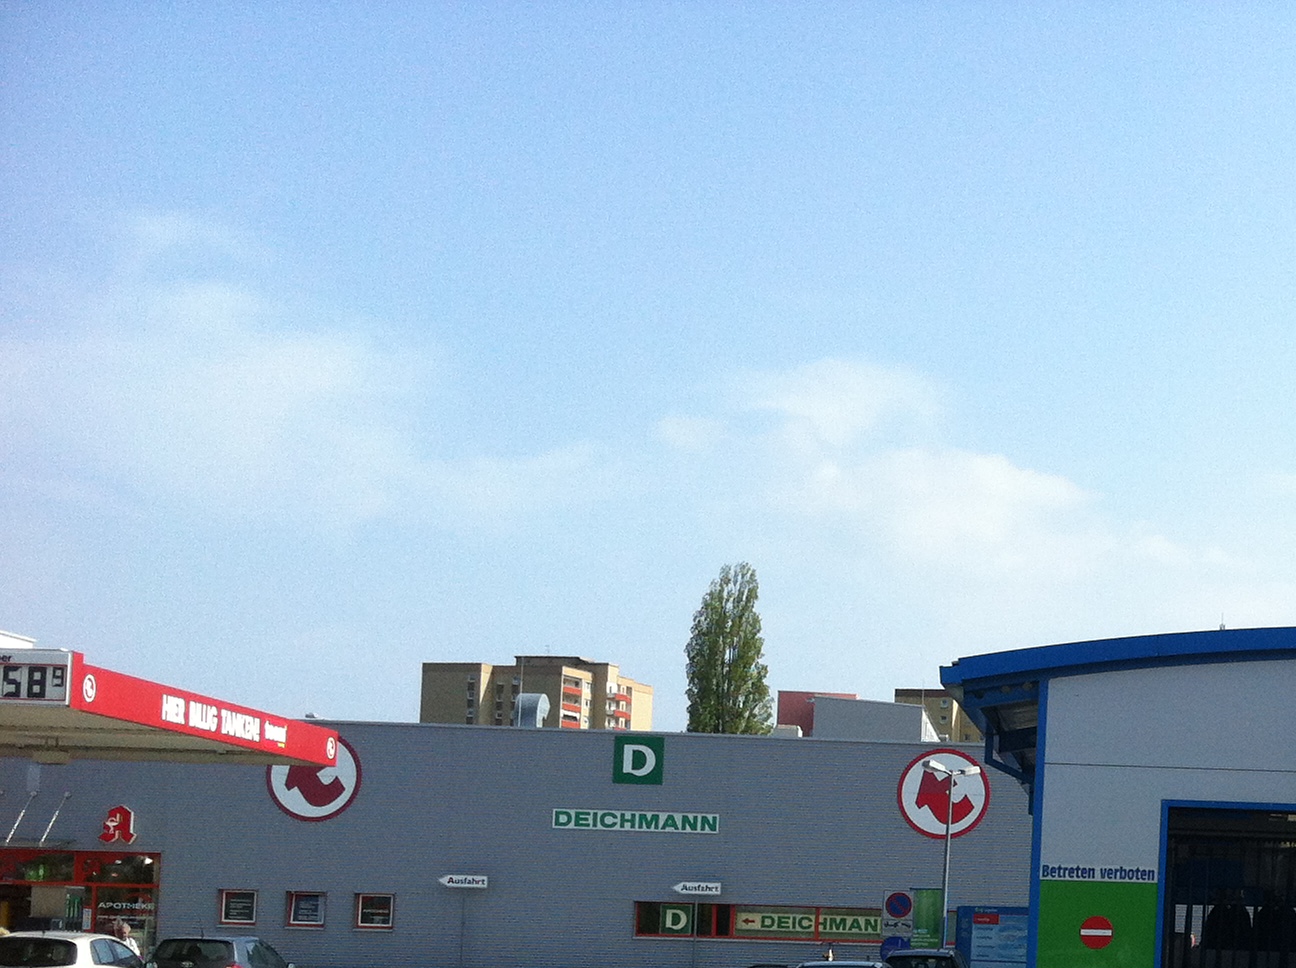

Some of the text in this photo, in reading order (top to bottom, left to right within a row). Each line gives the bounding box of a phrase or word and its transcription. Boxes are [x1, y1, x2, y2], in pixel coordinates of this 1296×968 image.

[622, 744, 656, 777] D
[554, 810, 718, 832] DEICHMANN
[446, 876, 486, 886] Ausfahrt
[1042, 864, 1156, 881] Betreten verboten
[680, 883, 719, 893] Ausfahrt
[98, 902, 155, 911] APOTHEKE
[665, 909, 688, 930] D
[760, 915, 882, 933] DEICHMAN
